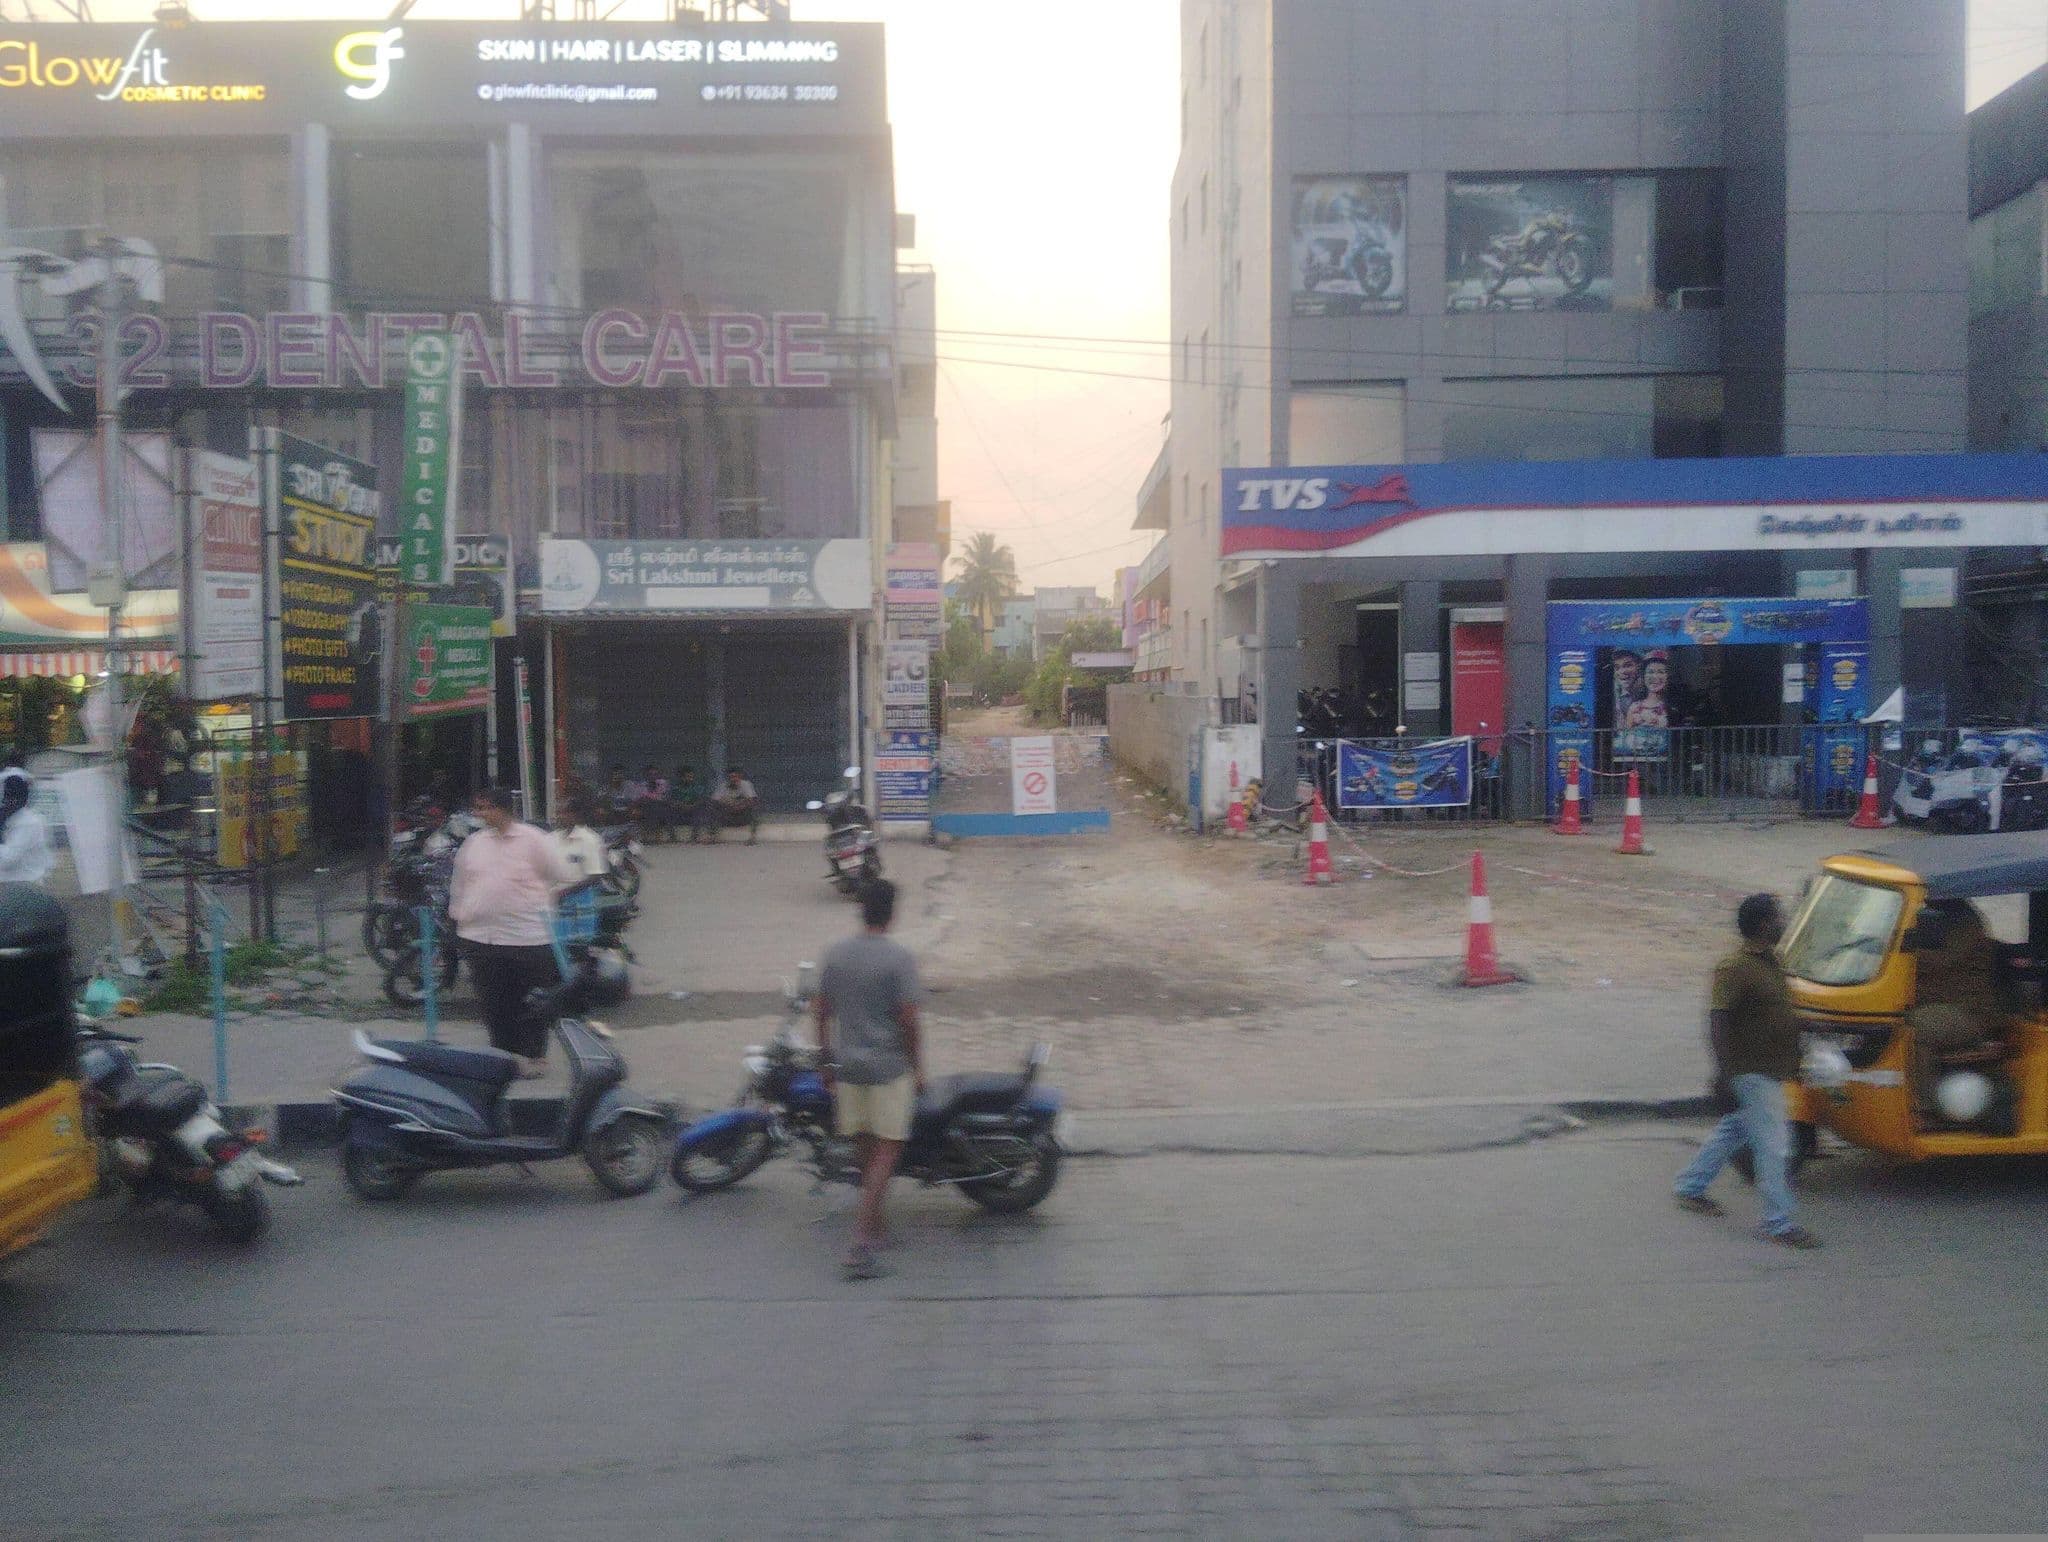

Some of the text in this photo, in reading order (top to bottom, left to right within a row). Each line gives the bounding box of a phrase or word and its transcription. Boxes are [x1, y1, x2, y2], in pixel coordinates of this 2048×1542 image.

[478, 39, 838, 62] SKIN HAIR LASER SLIMMING
[122, 85, 266, 102] COSMETIC CLINIC
[581, 308, 830, 389] CARE
[1236, 477, 1330, 512] TVS
[607, 568, 808, 585] Sri Lakshmi Jewellers
